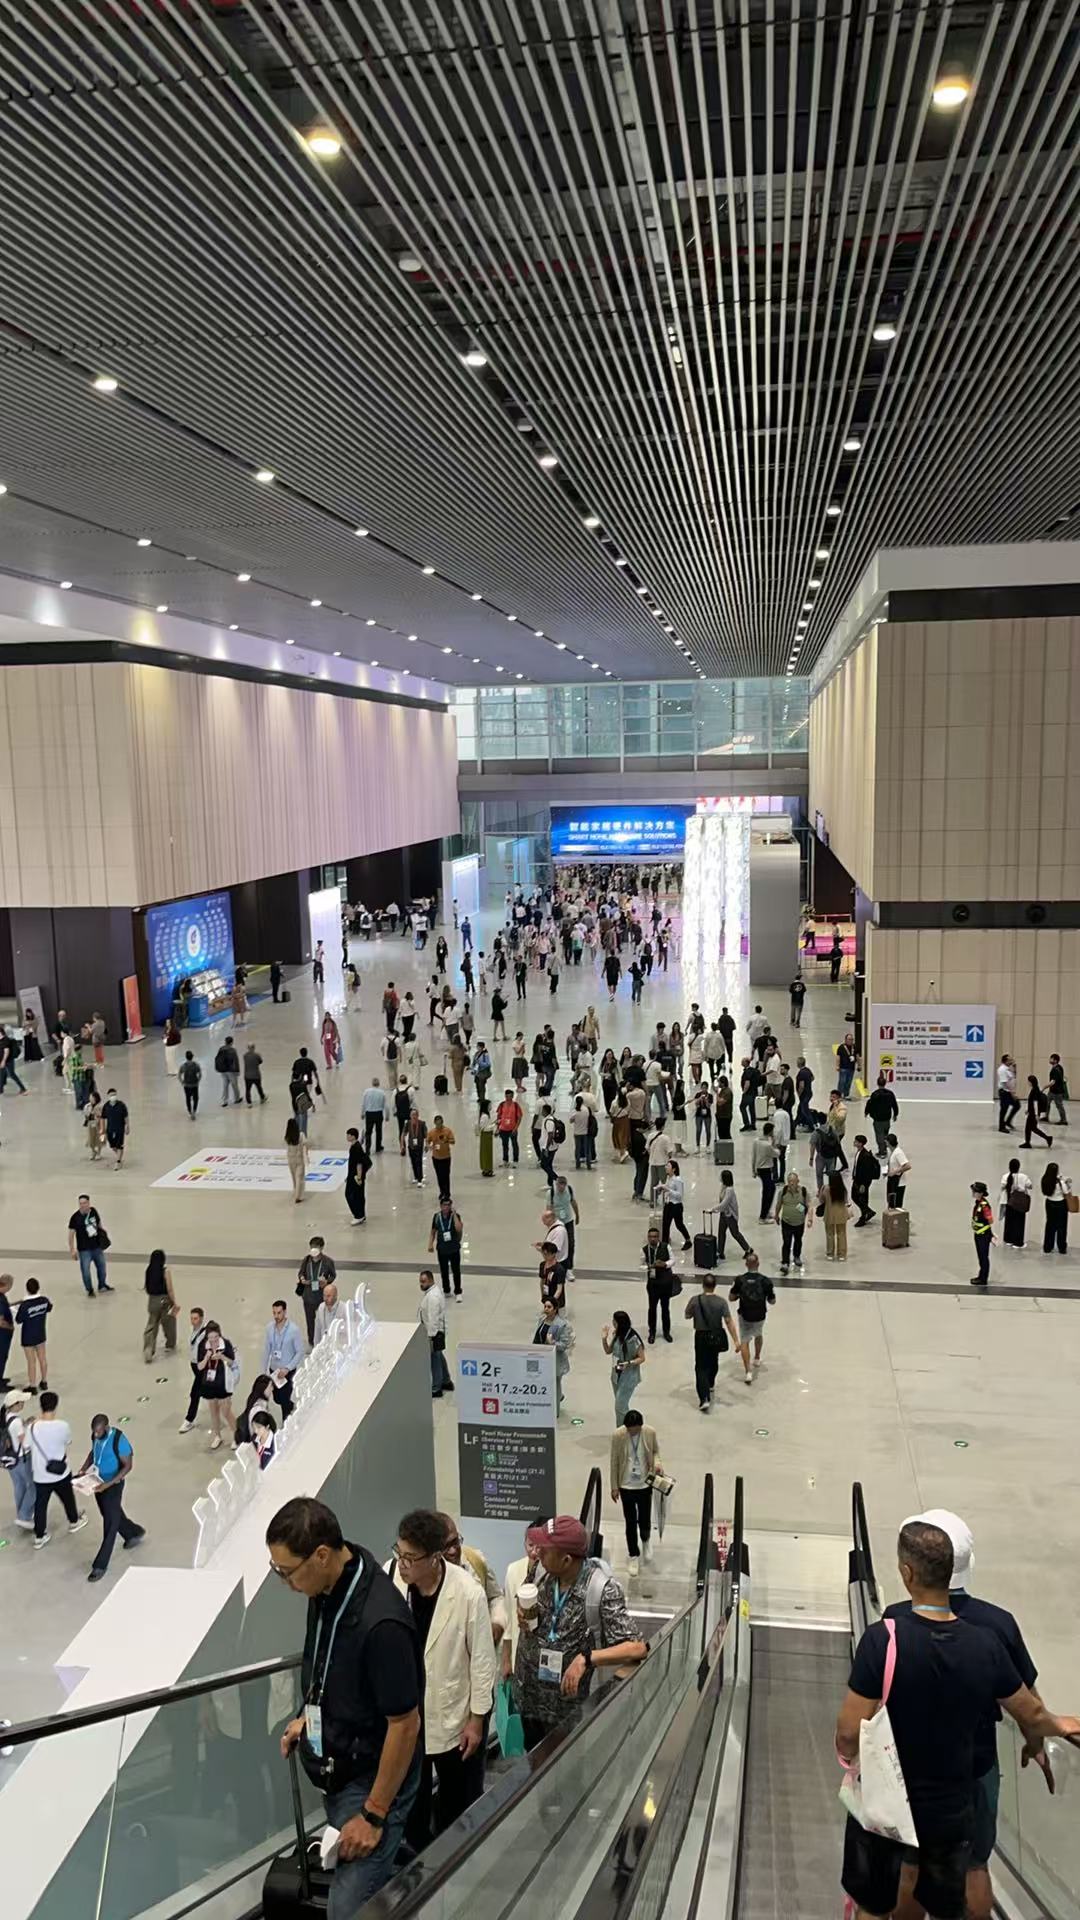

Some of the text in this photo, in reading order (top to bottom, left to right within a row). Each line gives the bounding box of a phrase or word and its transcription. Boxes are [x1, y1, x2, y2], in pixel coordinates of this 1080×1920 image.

[481, 1361, 502, 1377] 2F
[494, 1383, 547, 1395] 17.2-20.2
[463, 1433, 479, 1445] LF
